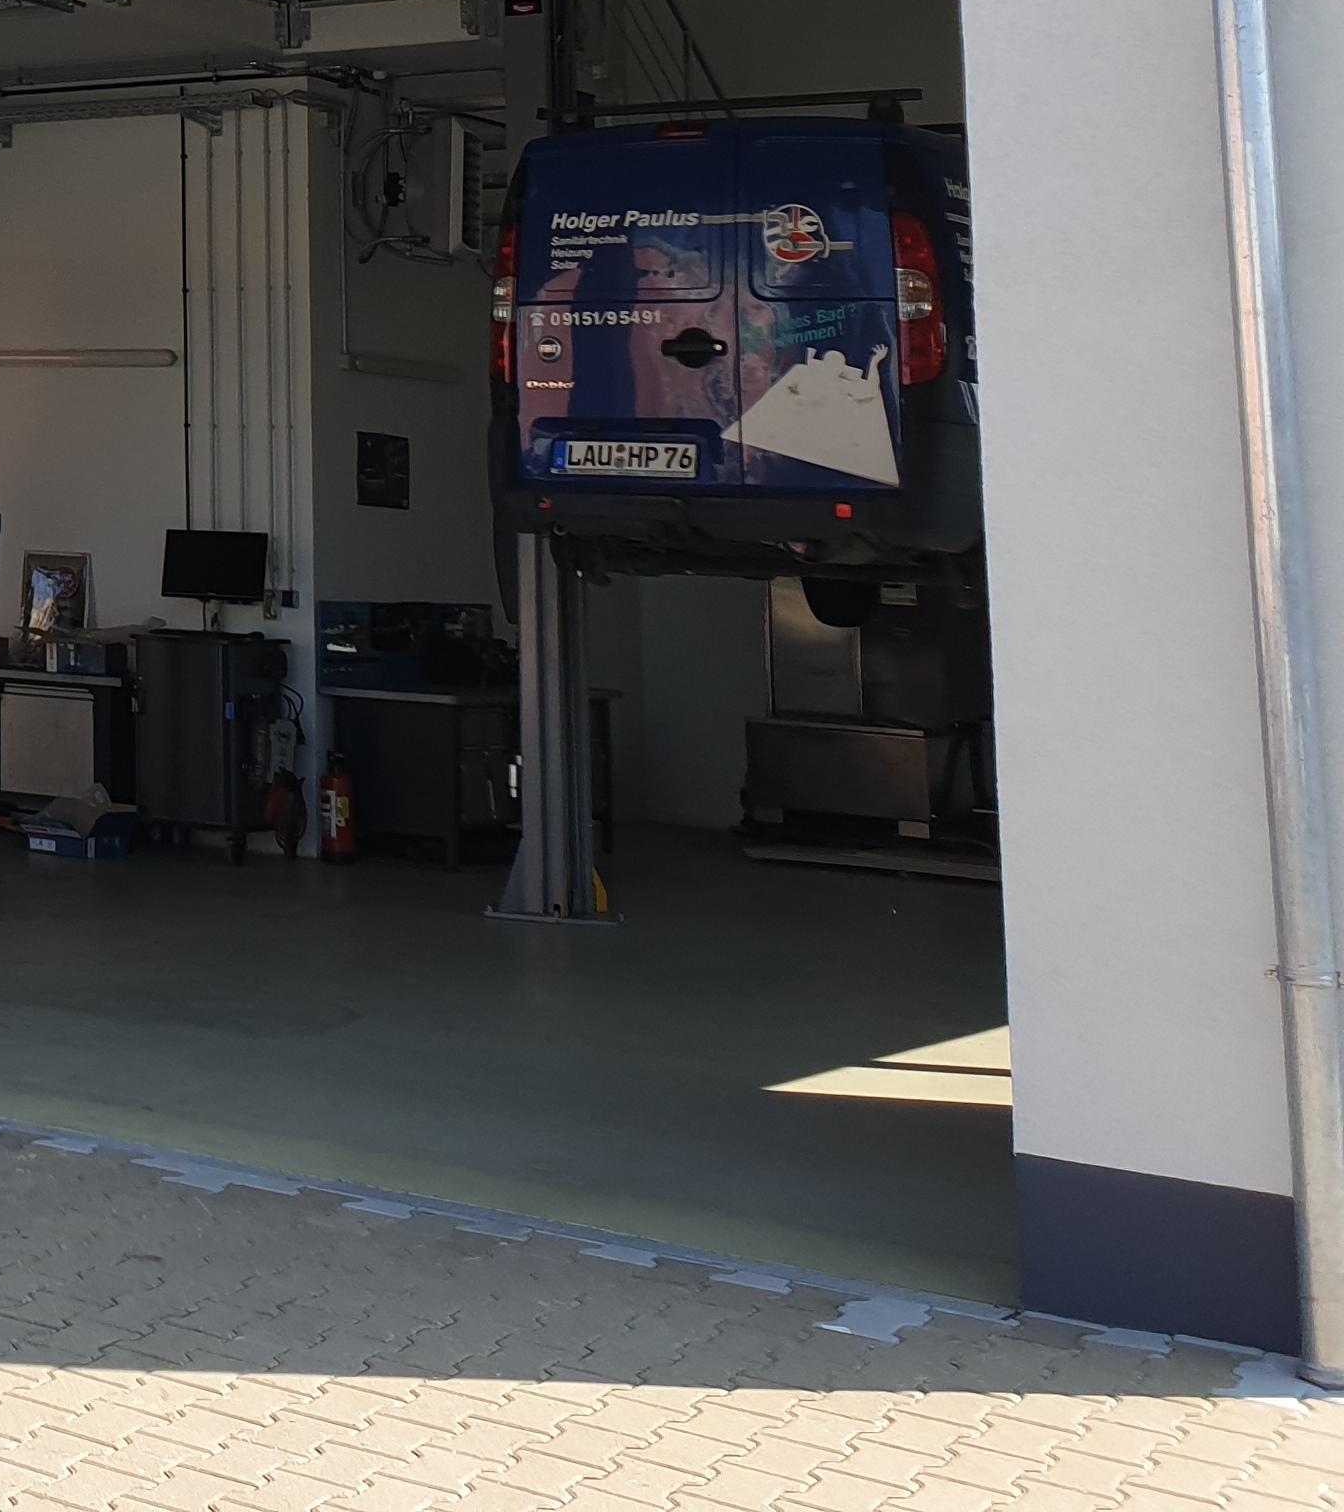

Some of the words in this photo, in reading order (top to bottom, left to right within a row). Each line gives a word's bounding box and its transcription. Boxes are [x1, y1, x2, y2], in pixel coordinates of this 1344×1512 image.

[550, 212, 621, 232] Holger
[623, 209, 700, 227] Paulus
[550, 248, 594, 259] Heizung
[550, 260, 580, 270] Solar
[567, 444, 612, 466] LAU
[628, 446, 659, 468] HP
[664, 447, 693, 469] 76
